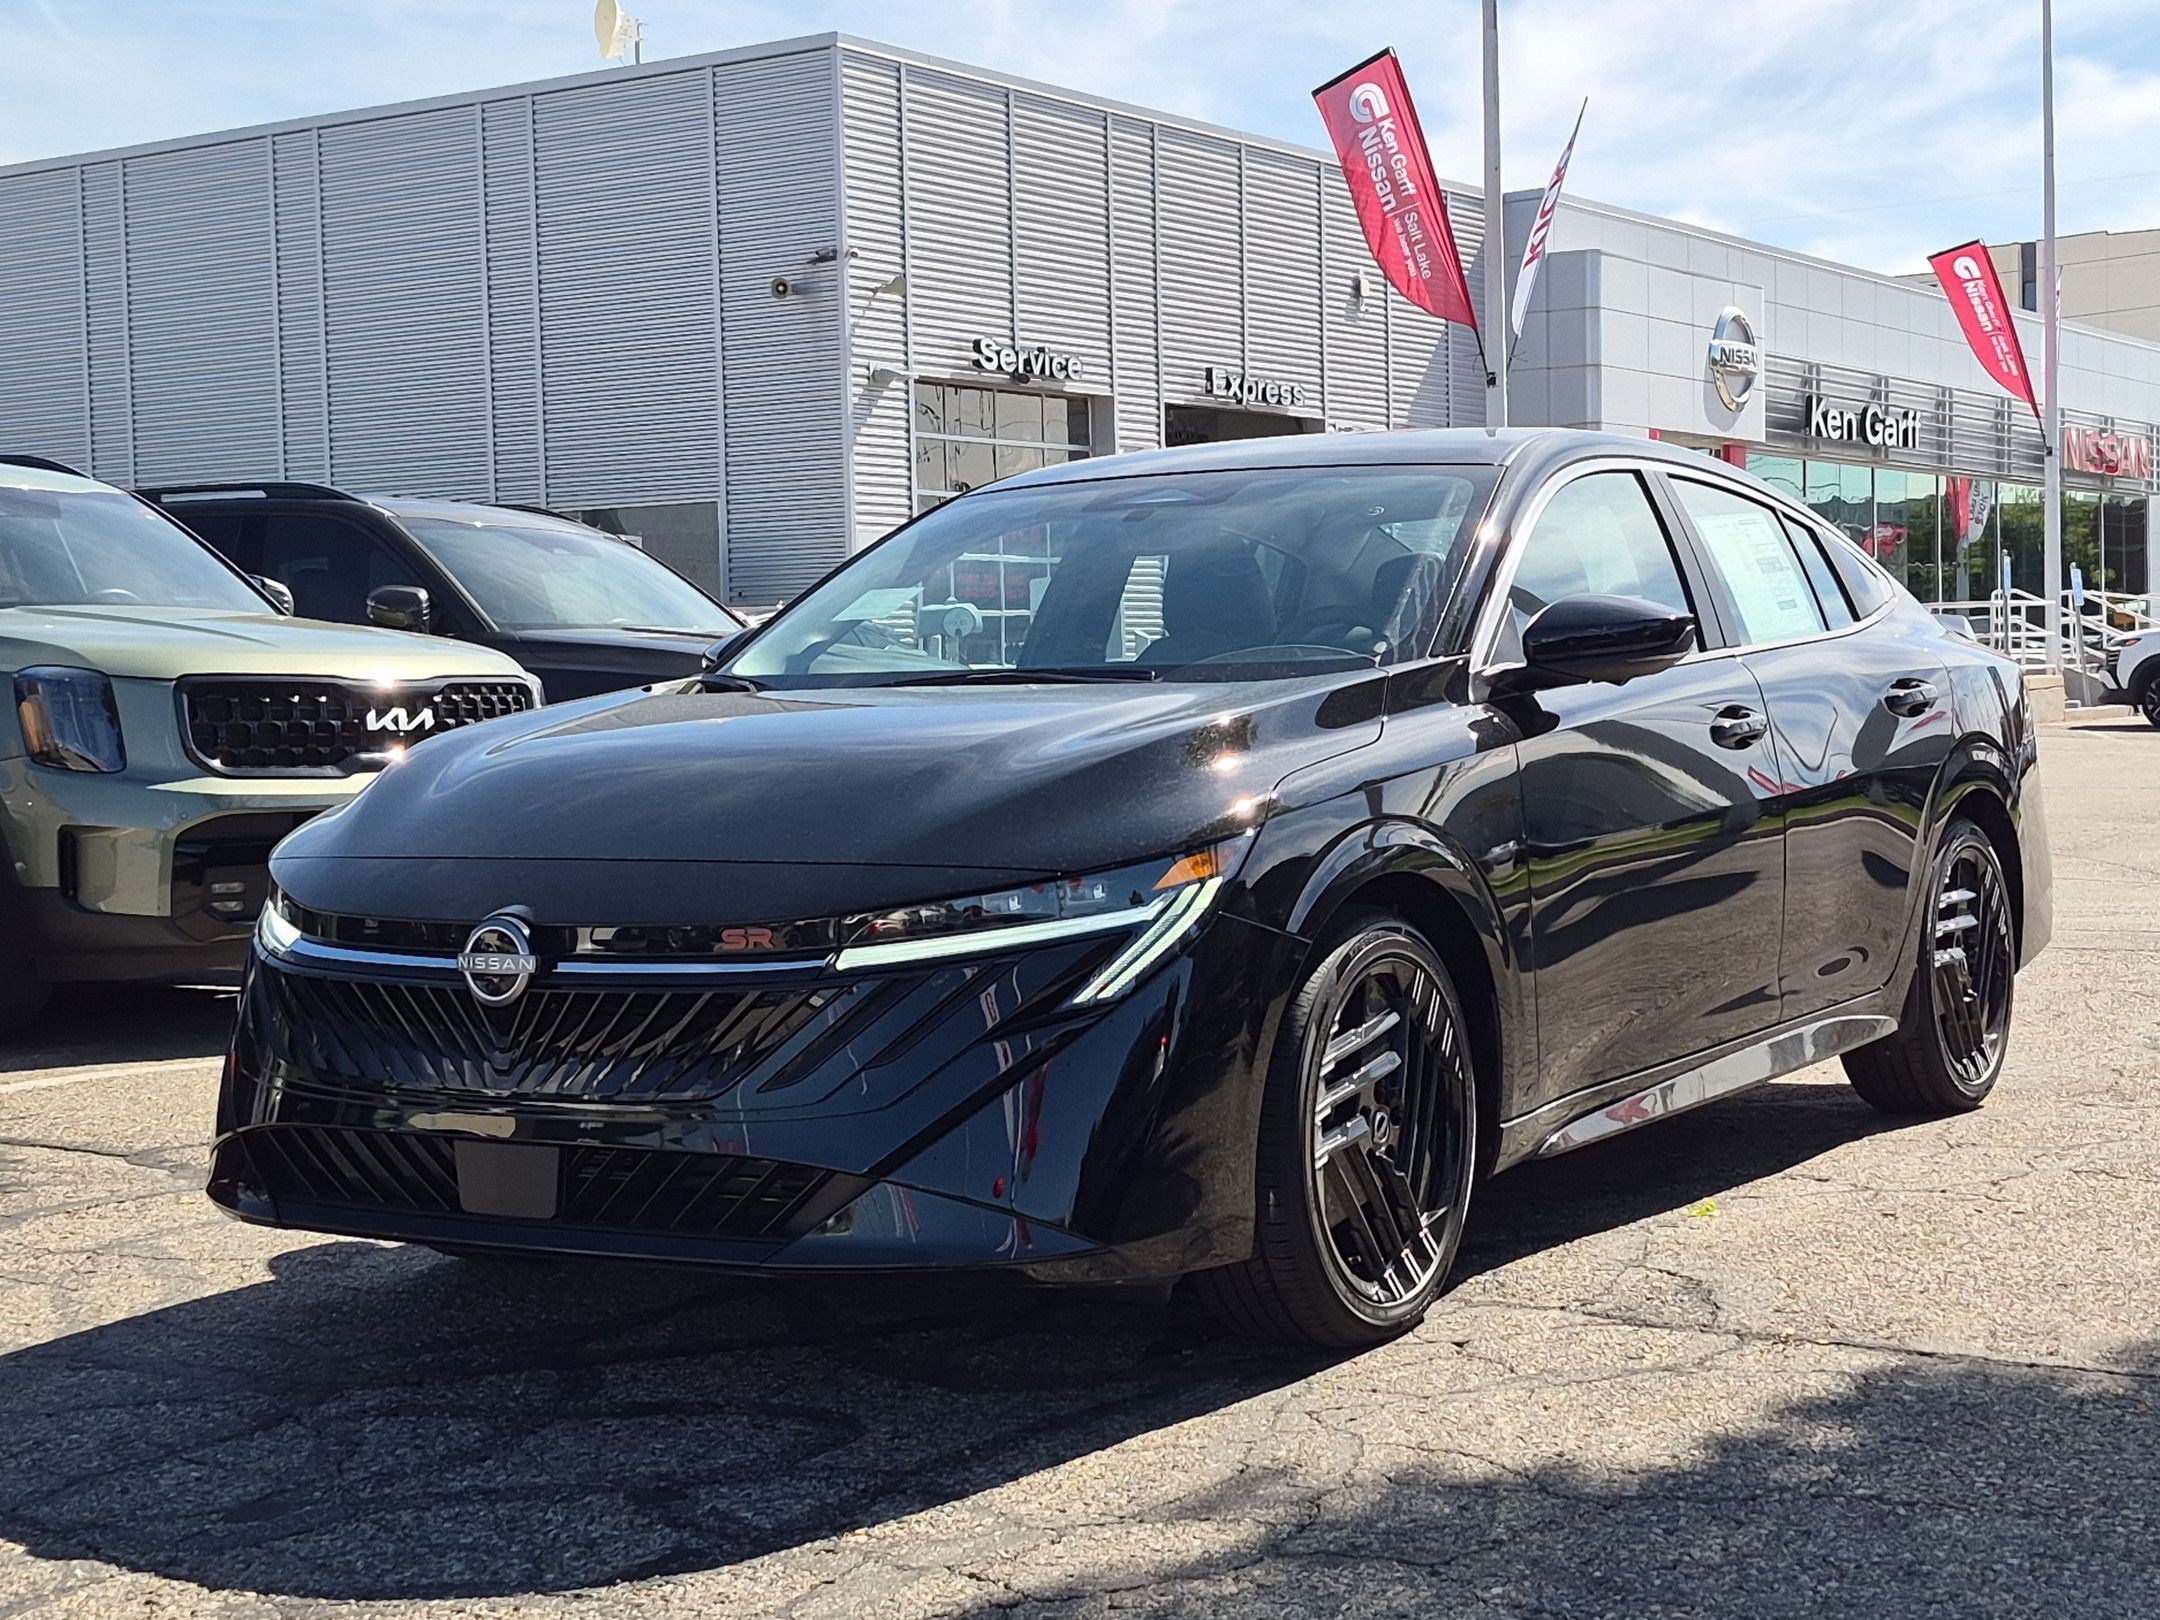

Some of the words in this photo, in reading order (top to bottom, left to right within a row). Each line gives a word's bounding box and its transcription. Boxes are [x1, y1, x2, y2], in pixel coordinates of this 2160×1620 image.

[1358, 126, 1397, 213] Nissan
[1377, 118, 1398, 155] Ken
[1391, 154, 1417, 196] Garff
[1404, 212, 1420, 242] Salt
[1415, 244, 1432, 279] Lake
[1405, 257, 1417, 278] you
[1962, 281, 1993, 332] Nissan
[979, 338, 1083, 380] Service
[1211, 368, 1305, 406] Express
[1810, 394, 1857, 441] Ken
[1864, 403, 1921, 449] Garff
[2063, 426, 2151, 480] NISSAN
[366, 707, 435, 731] KIA
[721, 928, 774, 950] SR
[458, 956, 533, 971] NISSAN
